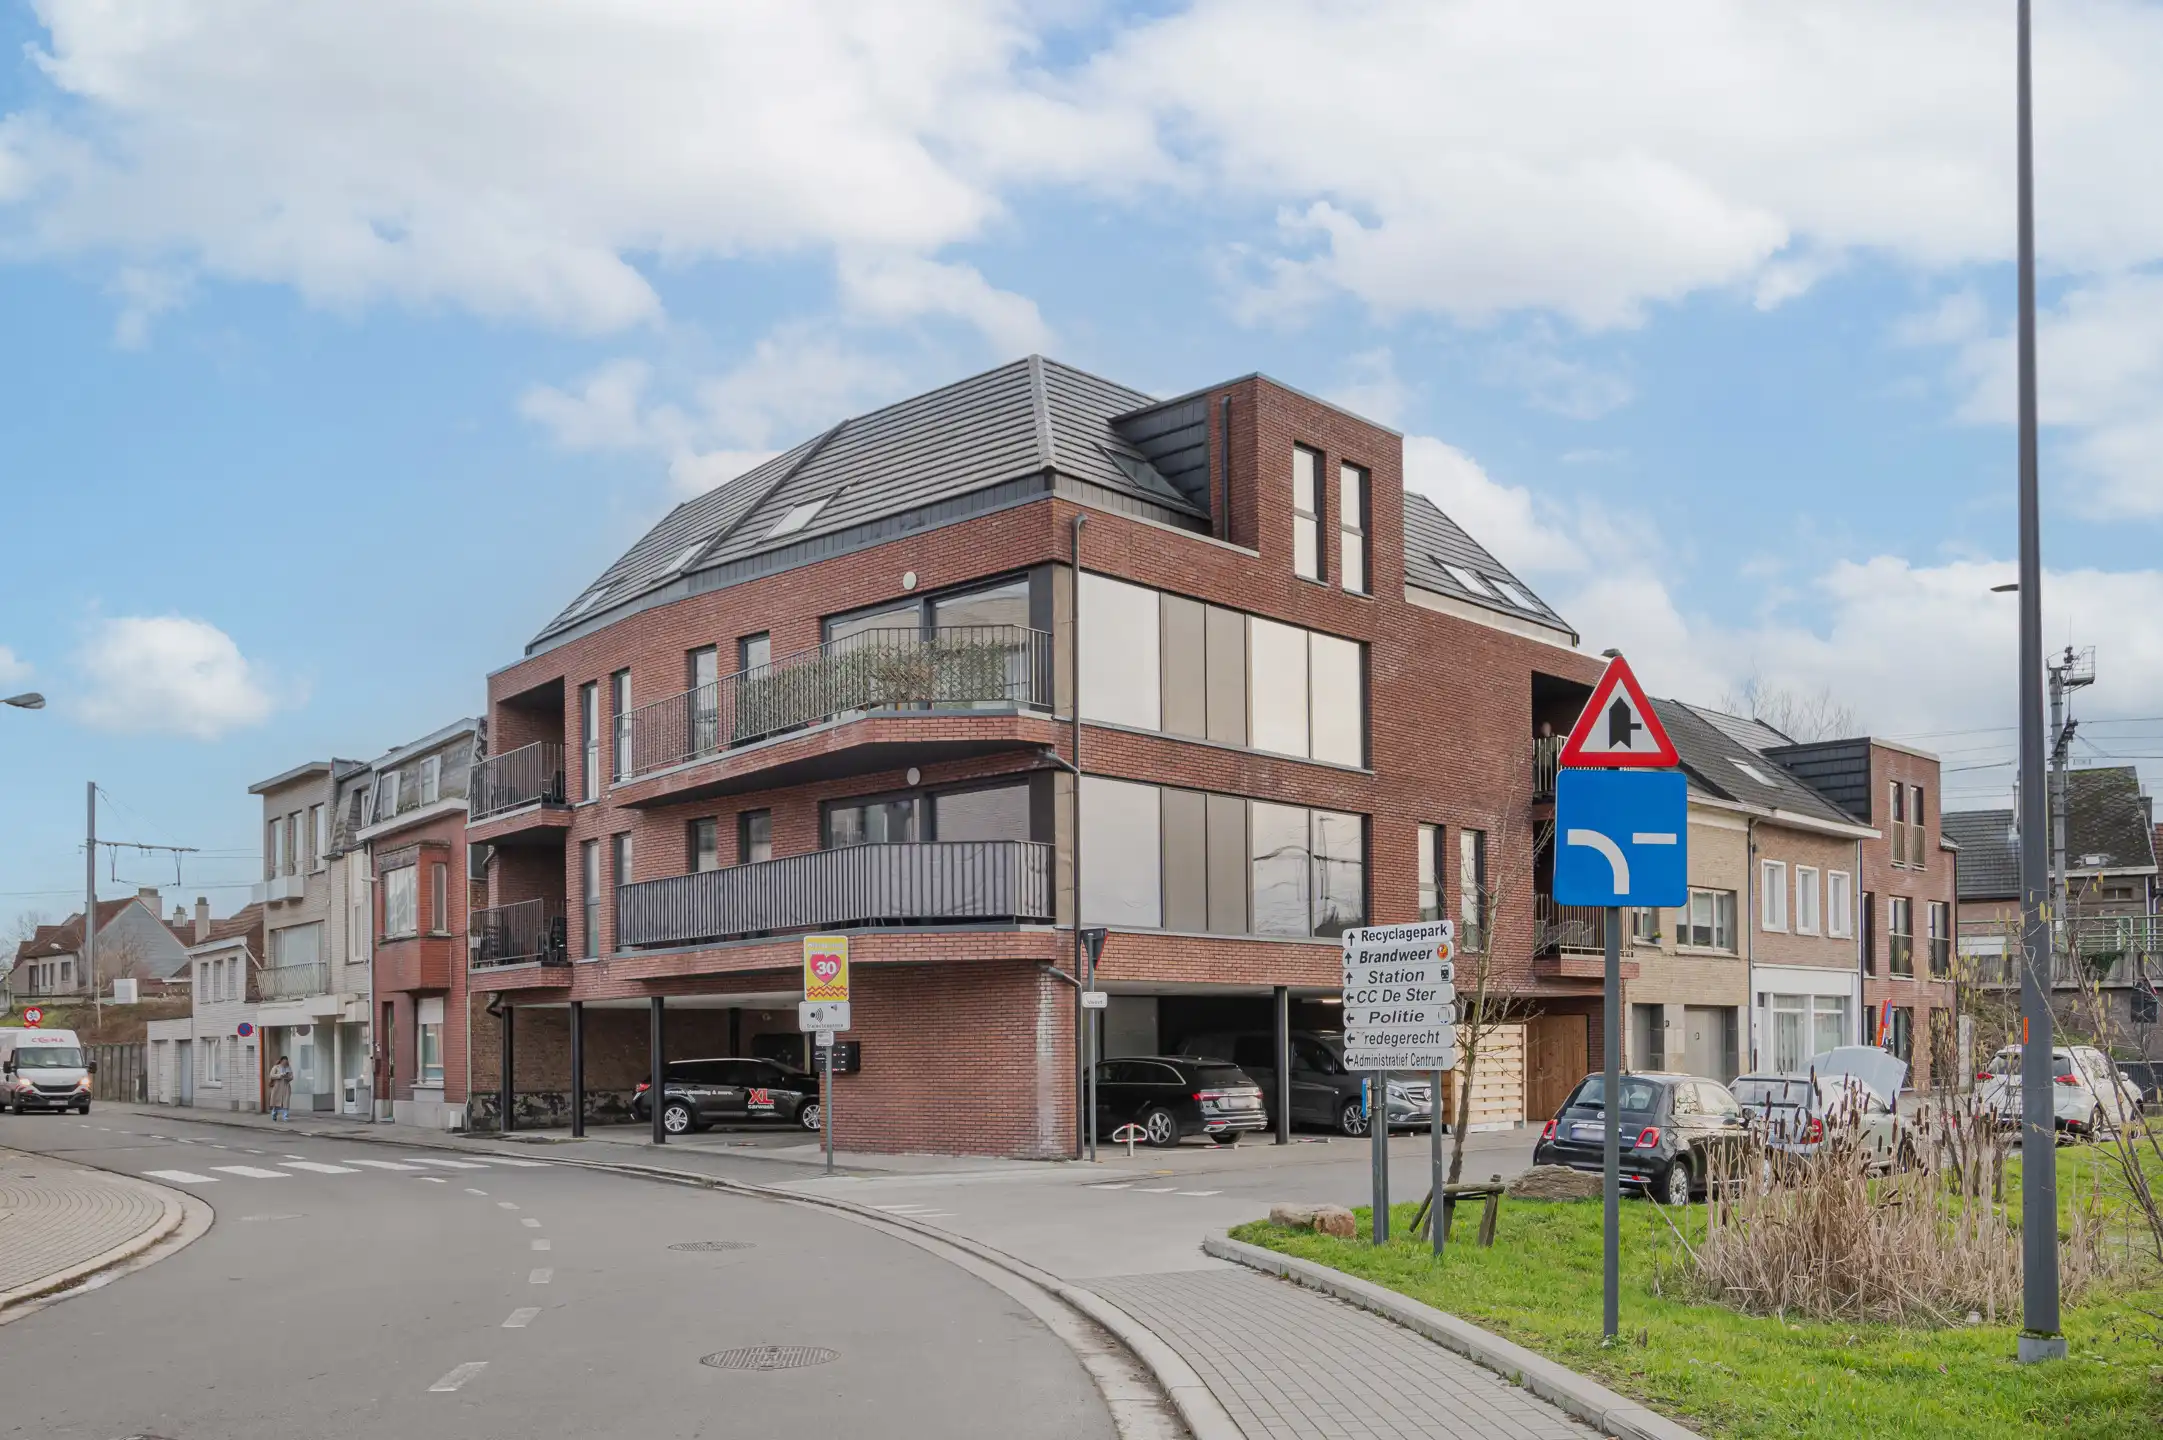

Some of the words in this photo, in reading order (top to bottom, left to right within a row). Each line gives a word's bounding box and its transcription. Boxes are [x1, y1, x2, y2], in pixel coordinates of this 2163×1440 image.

[1361, 924, 1447, 943] Recyclagepark
[1359, 949, 1433, 964] Brandweer
[816, 961, 837, 975] 30
[1368, 968, 1425, 984] Station
[1357, 990, 1378, 1004] CC
[1382, 989, 1401, 1003] De
[1405, 988, 1436, 1001] Ster
[1369, 1009, 1425, 1024] Politie
[1356, 1030, 1439, 1047] redegerecht
[1354, 1053, 1408, 1067] Administratief
[1410, 1052, 1444, 1067] Centrum
[747, 1088, 775, 1105] XL
